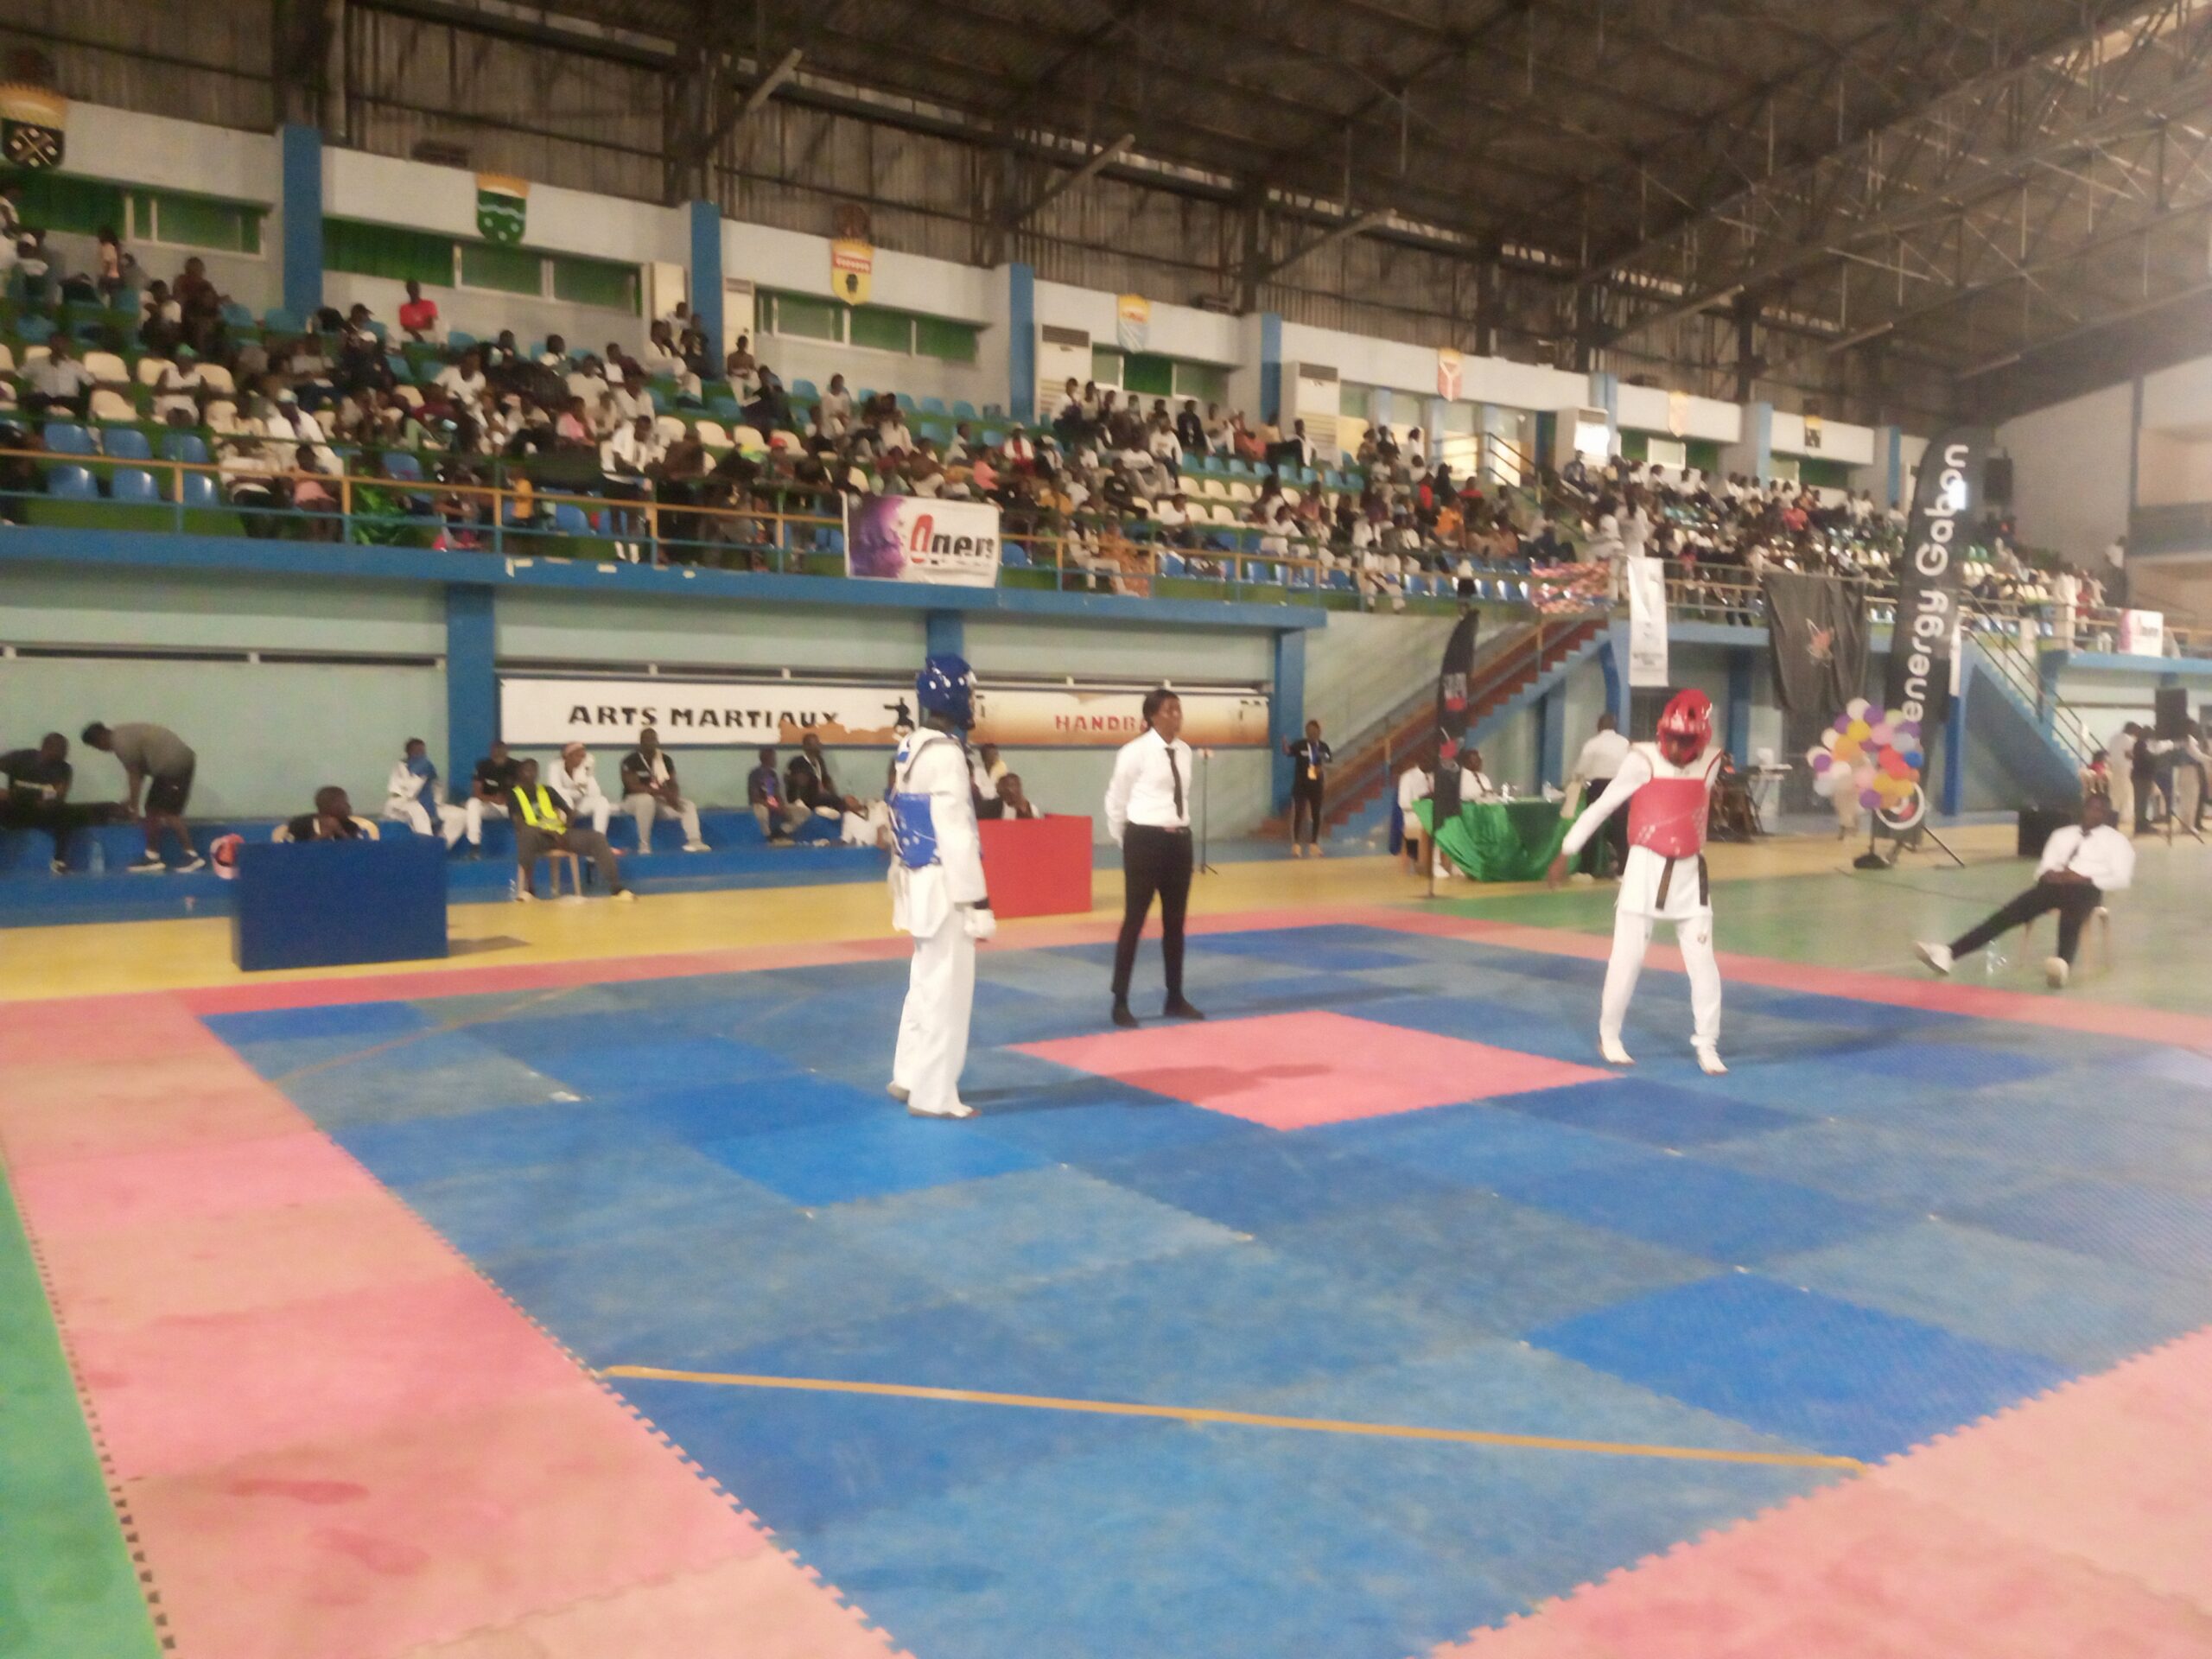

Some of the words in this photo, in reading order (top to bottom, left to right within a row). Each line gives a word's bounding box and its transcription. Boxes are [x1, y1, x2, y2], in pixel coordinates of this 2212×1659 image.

[1915, 443, 1969, 576] Gabon
[569, 706, 658, 726] ARTS
[670, 708, 839, 728] MARTIAUX
[1903, 590, 1948, 722] energy
